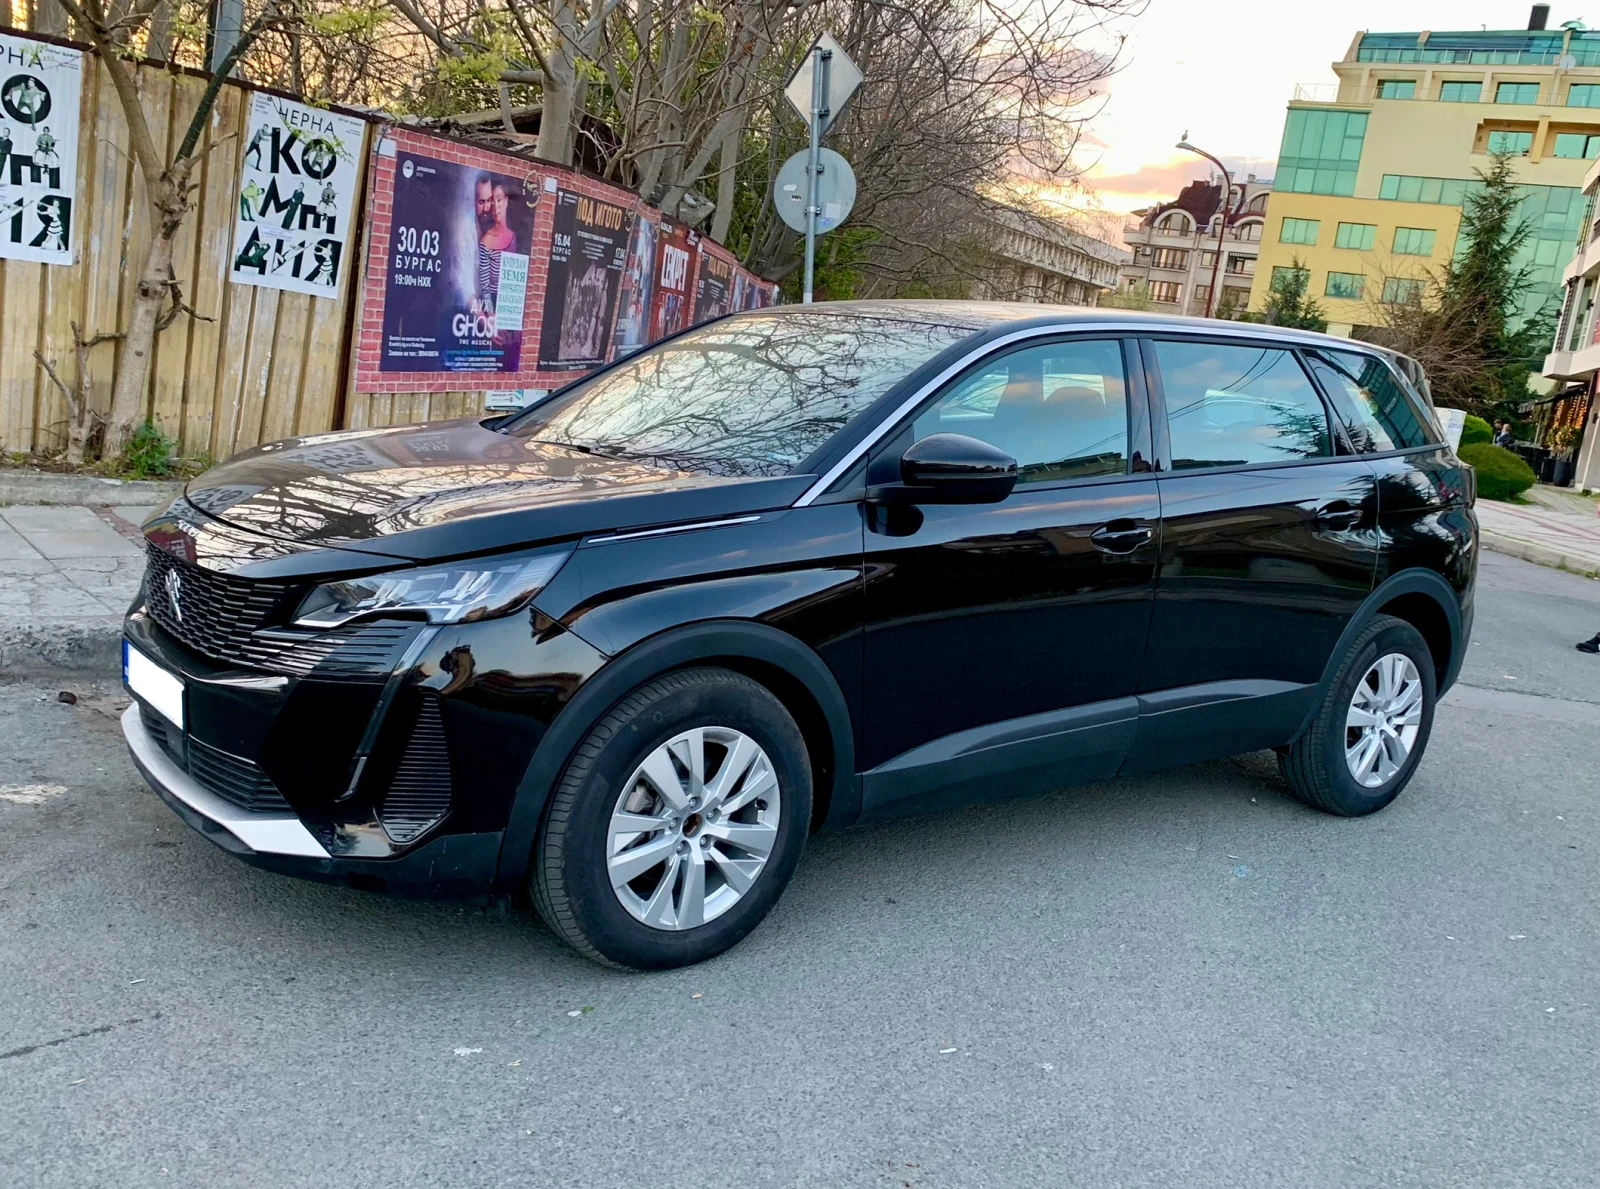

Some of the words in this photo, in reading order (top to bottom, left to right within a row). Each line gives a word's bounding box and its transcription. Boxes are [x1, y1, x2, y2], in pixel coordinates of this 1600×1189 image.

[279, 107, 335, 136] ЧЕРНА
[576, 197, 594, 227] ПОД
[594, 202, 623, 231] ИГОТО
[397, 225, 440, 257] 30.03
[554, 232, 571, 248] 16.04
[552, 245, 571, 256] БУРГАС
[395, 254, 442, 273] БУРГАС
[660, 243, 689, 292] СЕКРЕТ
[394, 273, 417, 287] 19:00ч
[417, 275, 432, 288] НХК
[501, 268, 526, 283] ЗЕМЯ
[459, 338, 469, 346] THE
